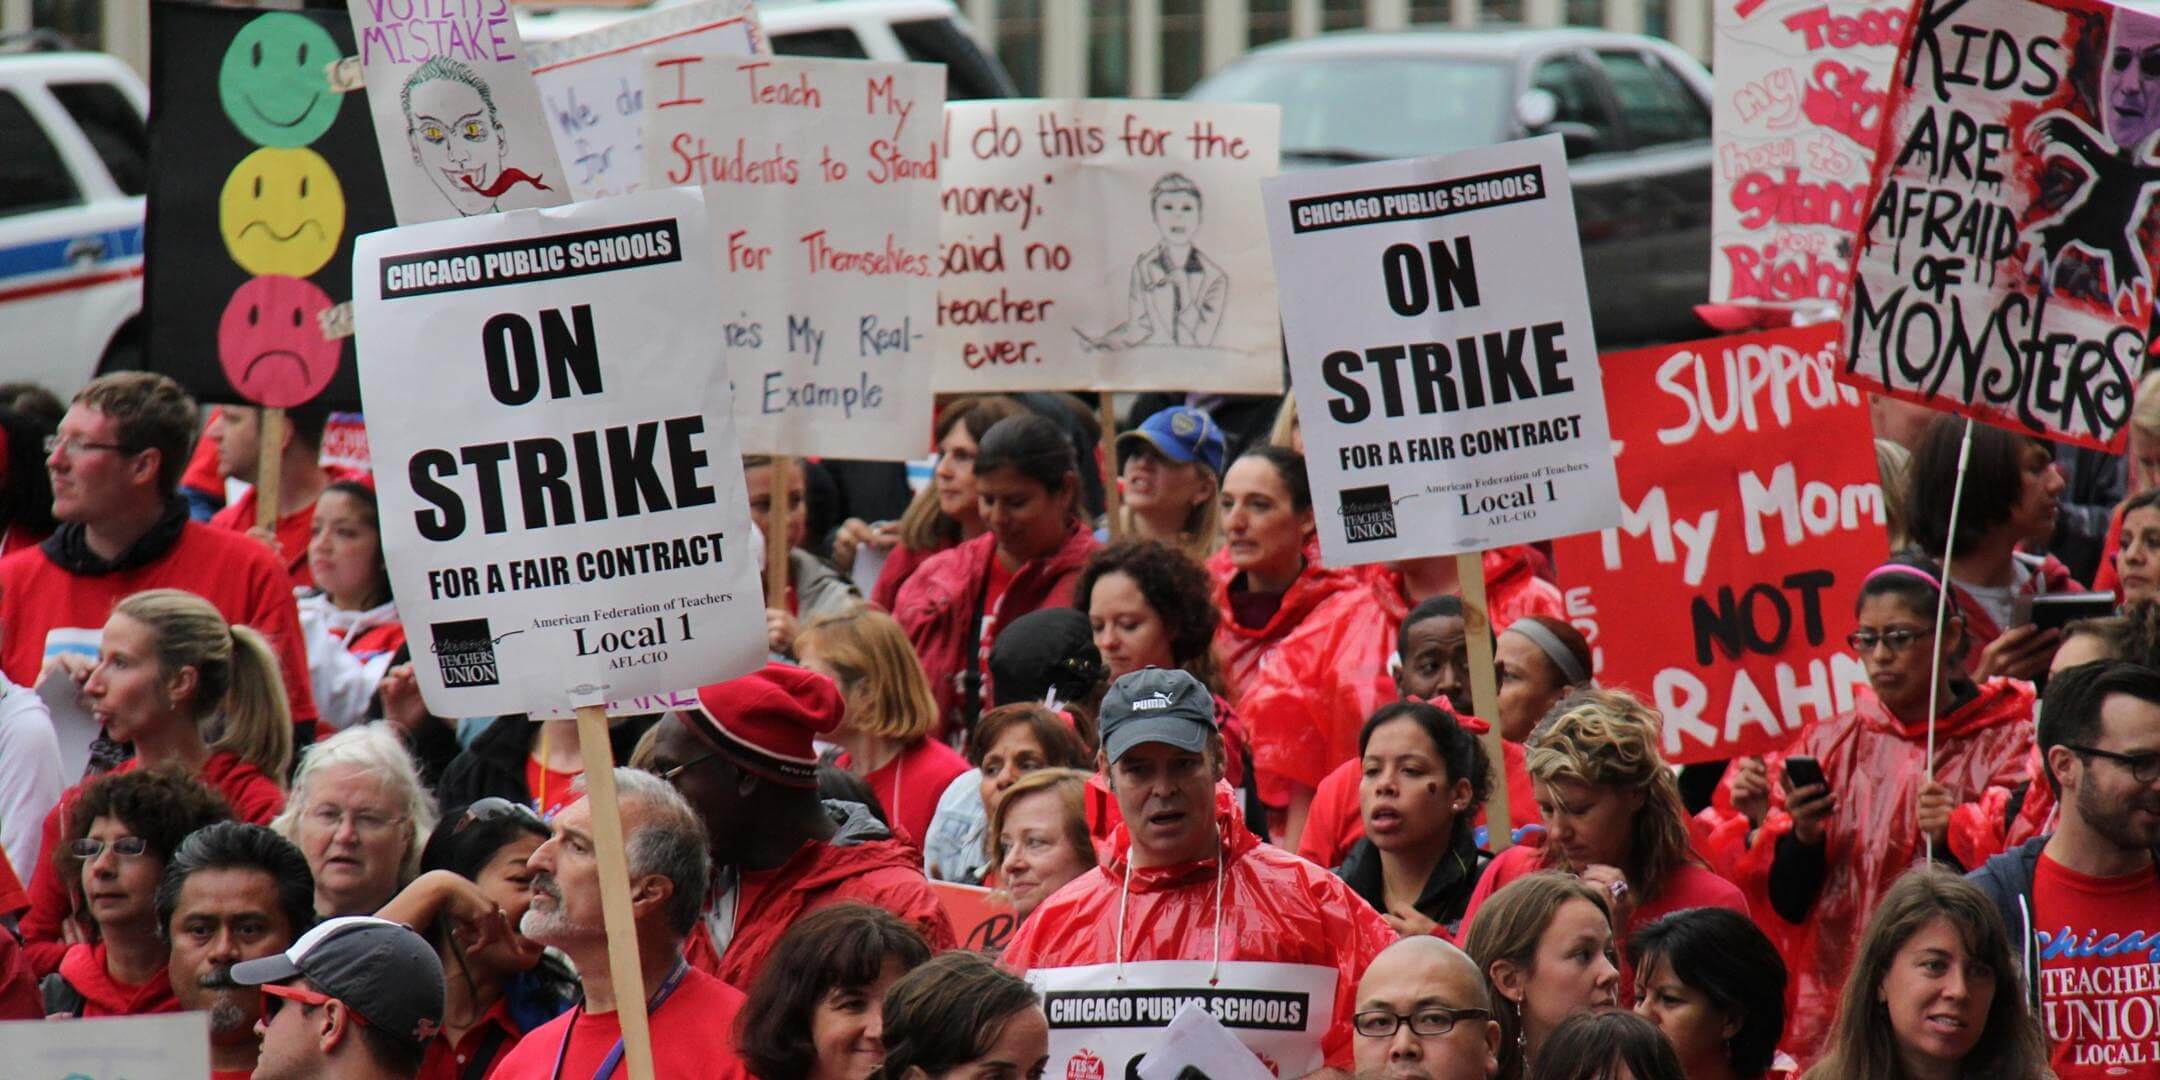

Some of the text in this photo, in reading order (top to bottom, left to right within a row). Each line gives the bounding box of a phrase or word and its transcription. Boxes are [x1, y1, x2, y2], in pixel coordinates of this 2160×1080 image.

[363, 18, 516, 66] MISTAKE
[1903, 0, 2062, 103] KIDS
[656, 56, 914, 141] I Teach My
[668, 132, 799, 185] Students
[820, 145, 848, 183] to
[868, 139, 938, 184] Stand
[972, 109, 1022, 160] do
[1038, 111, 1105, 158] this
[1119, 113, 1173, 157] for
[1187, 121, 1250, 160] the
[1889, 106, 2010, 184] ARE
[1298, 174, 1538, 228] CHICAGO PUBLIC SCHOOLS
[1866, 178, 2019, 264] AFRAID
[386, 229, 673, 292] CHICAGO PUBLIC SCHOOLS
[727, 229, 773, 272] For
[1025, 244, 1072, 271] no
[1382, 235, 1481, 318] ON
[1913, 254, 1966, 303] OF
[937, 288, 1055, 326] teacher
[482, 304, 604, 406] ON
[786, 313, 825, 366] My
[858, 314, 924, 357] Real-
[962, 340, 1042, 369] ever.
[761, 370, 883, 419] Example
[1321, 320, 1576, 424] STRIKE
[1339, 444, 1383, 471] FOR
[1388, 441, 1404, 465] A
[1406, 436, 1456, 463] FAIR
[1460, 415, 1582, 458] CONTRACT
[408, 415, 716, 542] STRIKE
[1425, 461, 1590, 494] American Federation of Teachers
[1459, 480, 1559, 517] Local 1
[1346, 521, 1396, 540] UNION
[1487, 508, 1537, 528] AFL-CIO
[1601, 461, 1888, 586] My Mom
[428, 533, 725, 601] FOR A FAIR CONTRACT
[532, 591, 733, 630] American Federation of Teachers
[1691, 570, 1835, 667] NOT
[438, 650, 495, 667] TEACHERS
[573, 613, 696, 657] Local 1
[442, 664, 497, 684] UNION
[608, 650, 669, 671] AFL-CIO
[1133, 698, 1167, 711] PUMA
[2037, 926, 2160, 962] hica
[1051, 998, 1131, 1023] CHICAGO
[1211, 998, 1301, 1025] SCHOOLS
[2043, 996, 2160, 1041] UNIO
[2074, 1042, 2146, 1065] LOCAL
